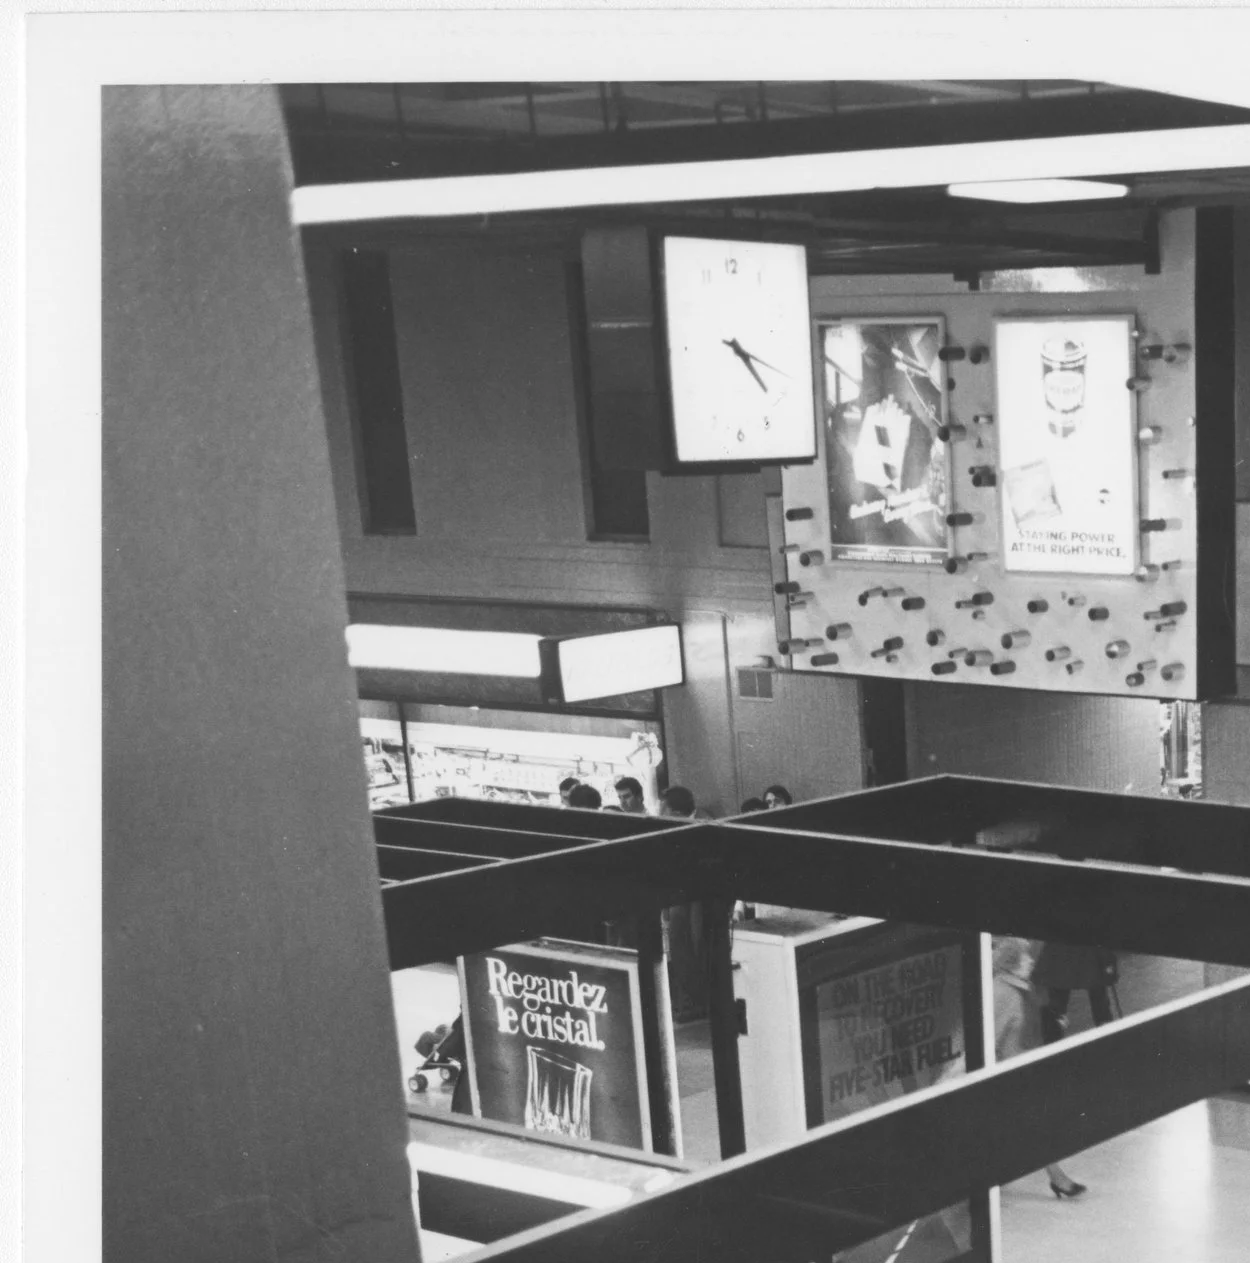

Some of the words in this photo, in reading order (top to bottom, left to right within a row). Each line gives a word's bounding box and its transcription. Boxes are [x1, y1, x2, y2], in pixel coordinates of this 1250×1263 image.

[725, 258, 738, 274] 12
[1018, 530, 1067, 542] STAYING
[1071, 531, 1115, 543] POWER
[1011, 542, 1025, 552] AT
[1050, 544, 1086, 556] RIGHT
[485, 956, 609, 1014] Regardez
[494, 993, 520, 1035] le
[521, 1006, 606, 1051] cristal.
